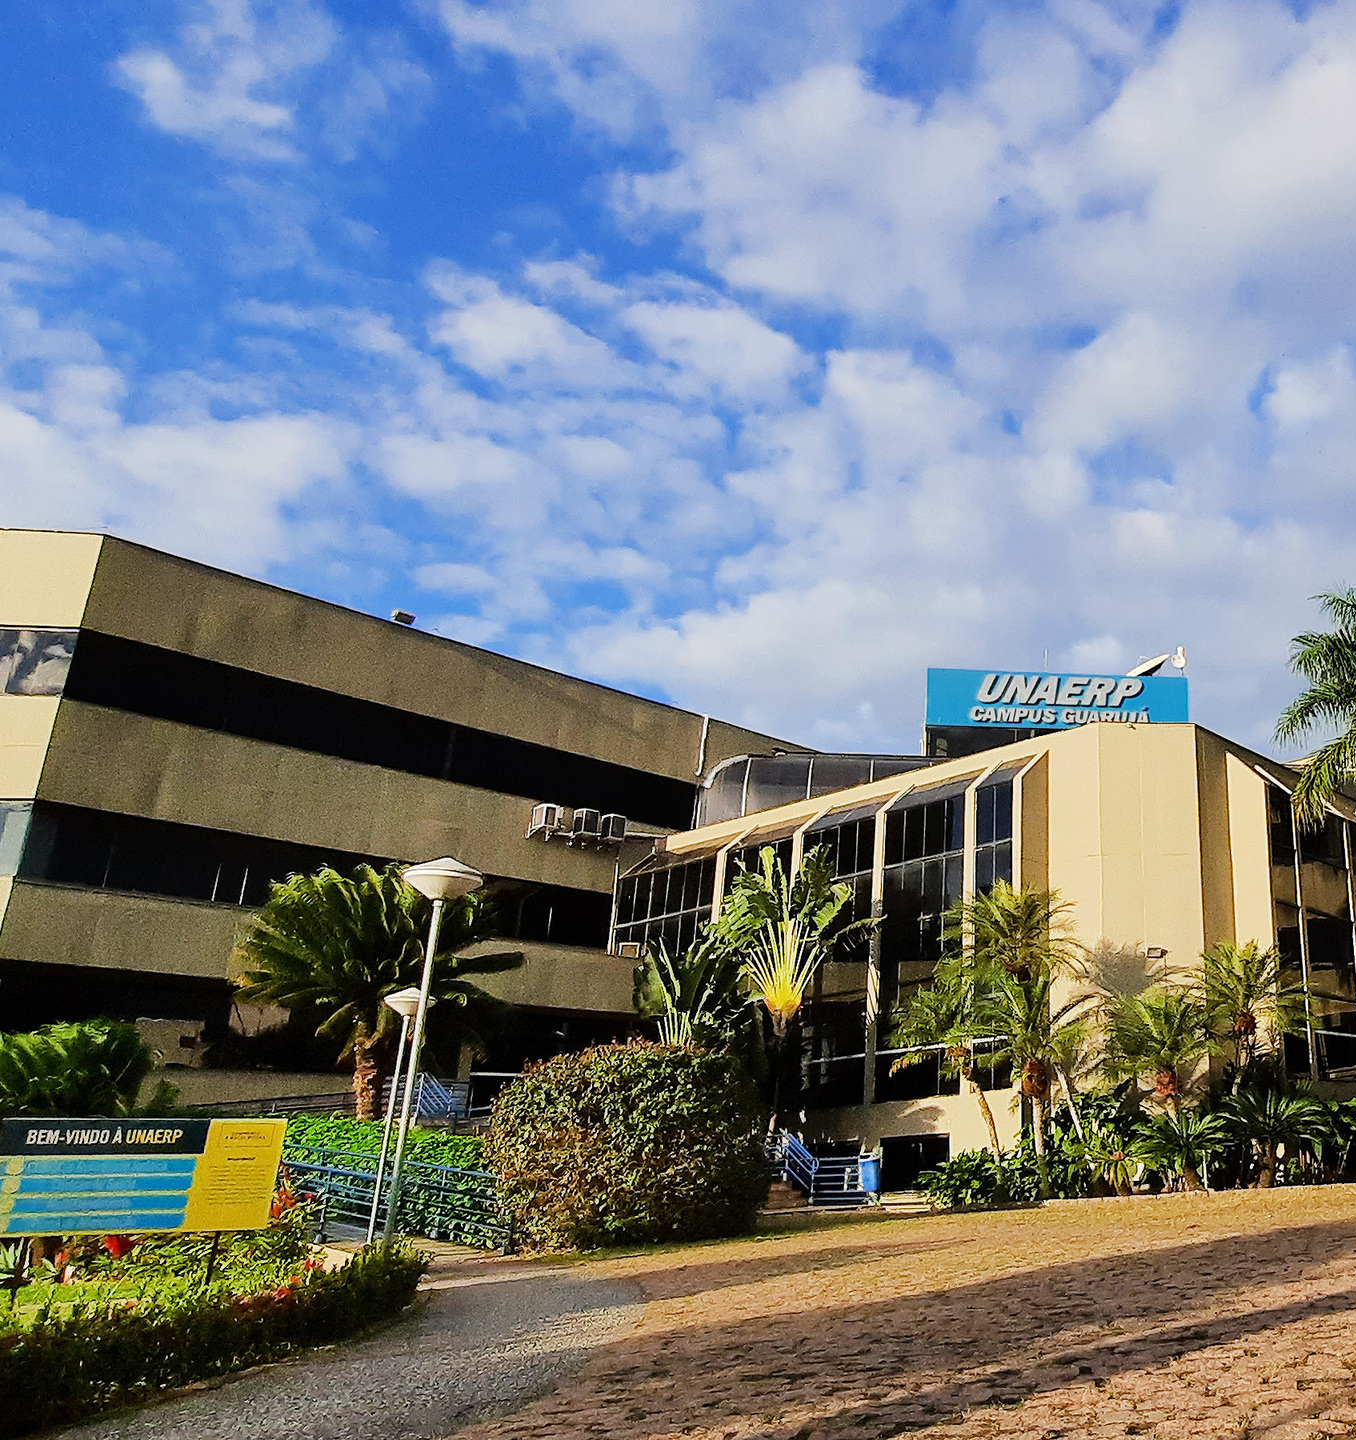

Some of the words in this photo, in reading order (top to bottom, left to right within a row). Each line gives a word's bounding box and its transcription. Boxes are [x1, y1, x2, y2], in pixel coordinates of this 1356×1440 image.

[976, 673, 1144, 707] UNAERP
[970, 706, 1056, 724] CAMPUS
[25, 1129, 110, 1146] BEM-VINDO
[111, 1125, 123, 1144] À
[126, 1129, 184, 1145] UNAERP
